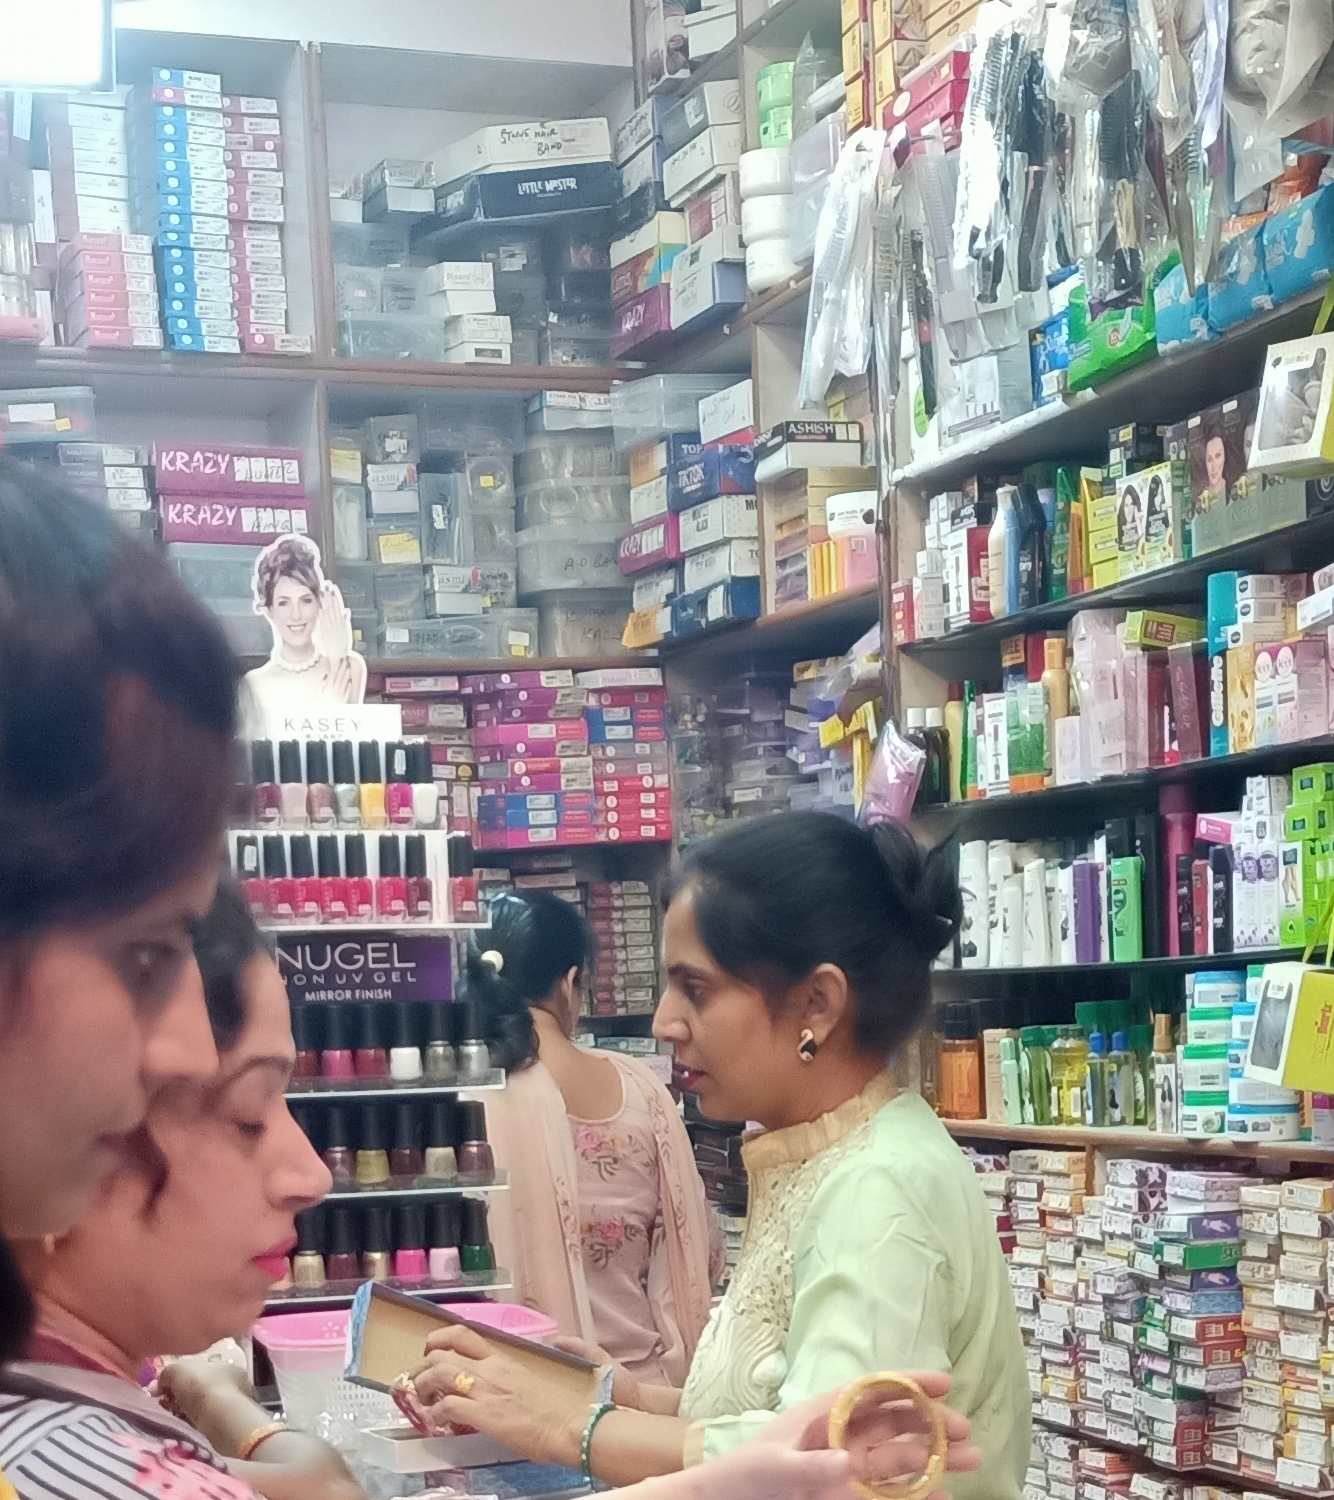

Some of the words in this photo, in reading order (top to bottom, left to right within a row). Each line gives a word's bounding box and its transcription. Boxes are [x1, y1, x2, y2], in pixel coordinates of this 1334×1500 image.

[788, 422, 834, 435] ASHISH
[682, 444, 703, 454] TOP
[161, 450, 230, 475] KRAZY
[167, 503, 237, 527] KRAZY
[284, 717, 362, 732] KASEY
[275, 942, 417, 971] NUGEL
[335, 972, 363, 985] UV
[373, 971, 417, 983] GEL
[305, 989, 352, 1001] MIRROR
[355, 988, 392, 999] FINISH
